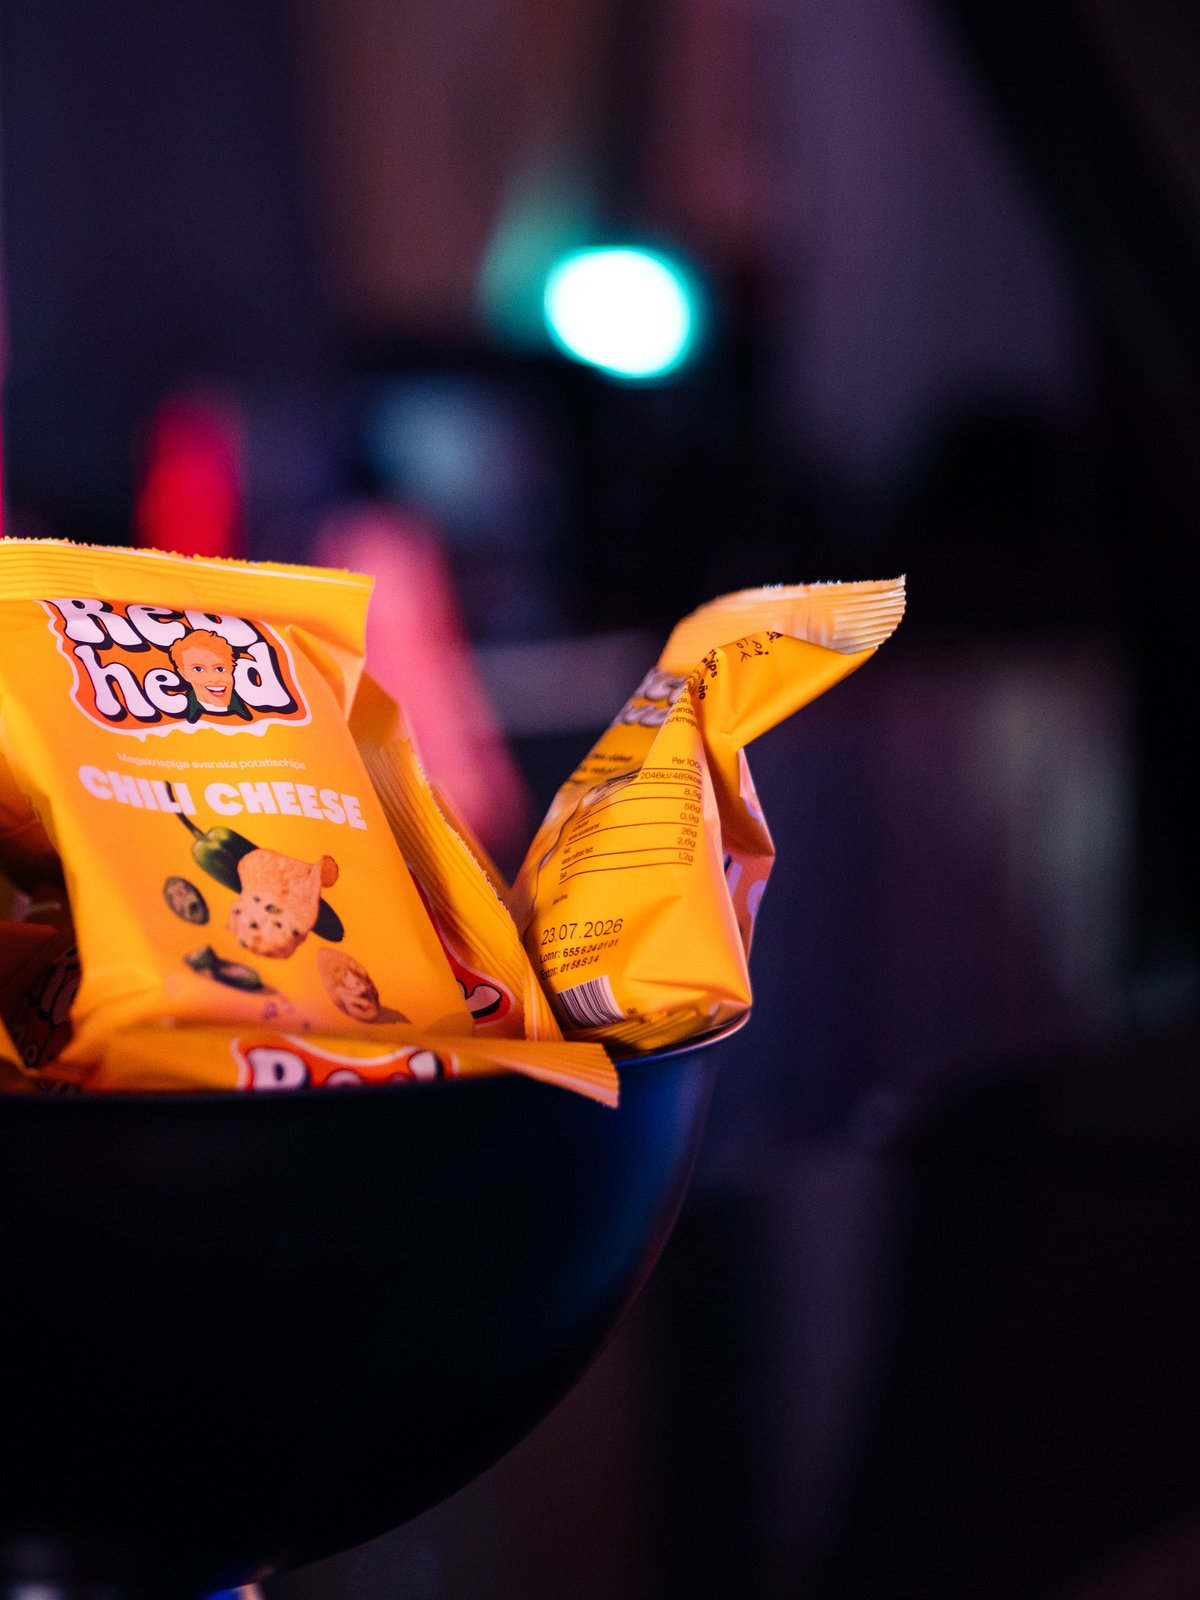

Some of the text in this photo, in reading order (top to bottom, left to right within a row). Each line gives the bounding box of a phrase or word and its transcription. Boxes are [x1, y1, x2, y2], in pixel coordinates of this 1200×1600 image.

[73, 641, 298, 722] hed
[192, 759, 237, 769] svenska
[240, 757, 307, 771] potatischips
[672, 757, 685, 765] Per
[78, 765, 368, 830] CHILI CHEESE
[684, 803, 701, 814] 56g
[681, 827, 697, 838] 26g
[541, 918, 624, 946] 23.07.2026
